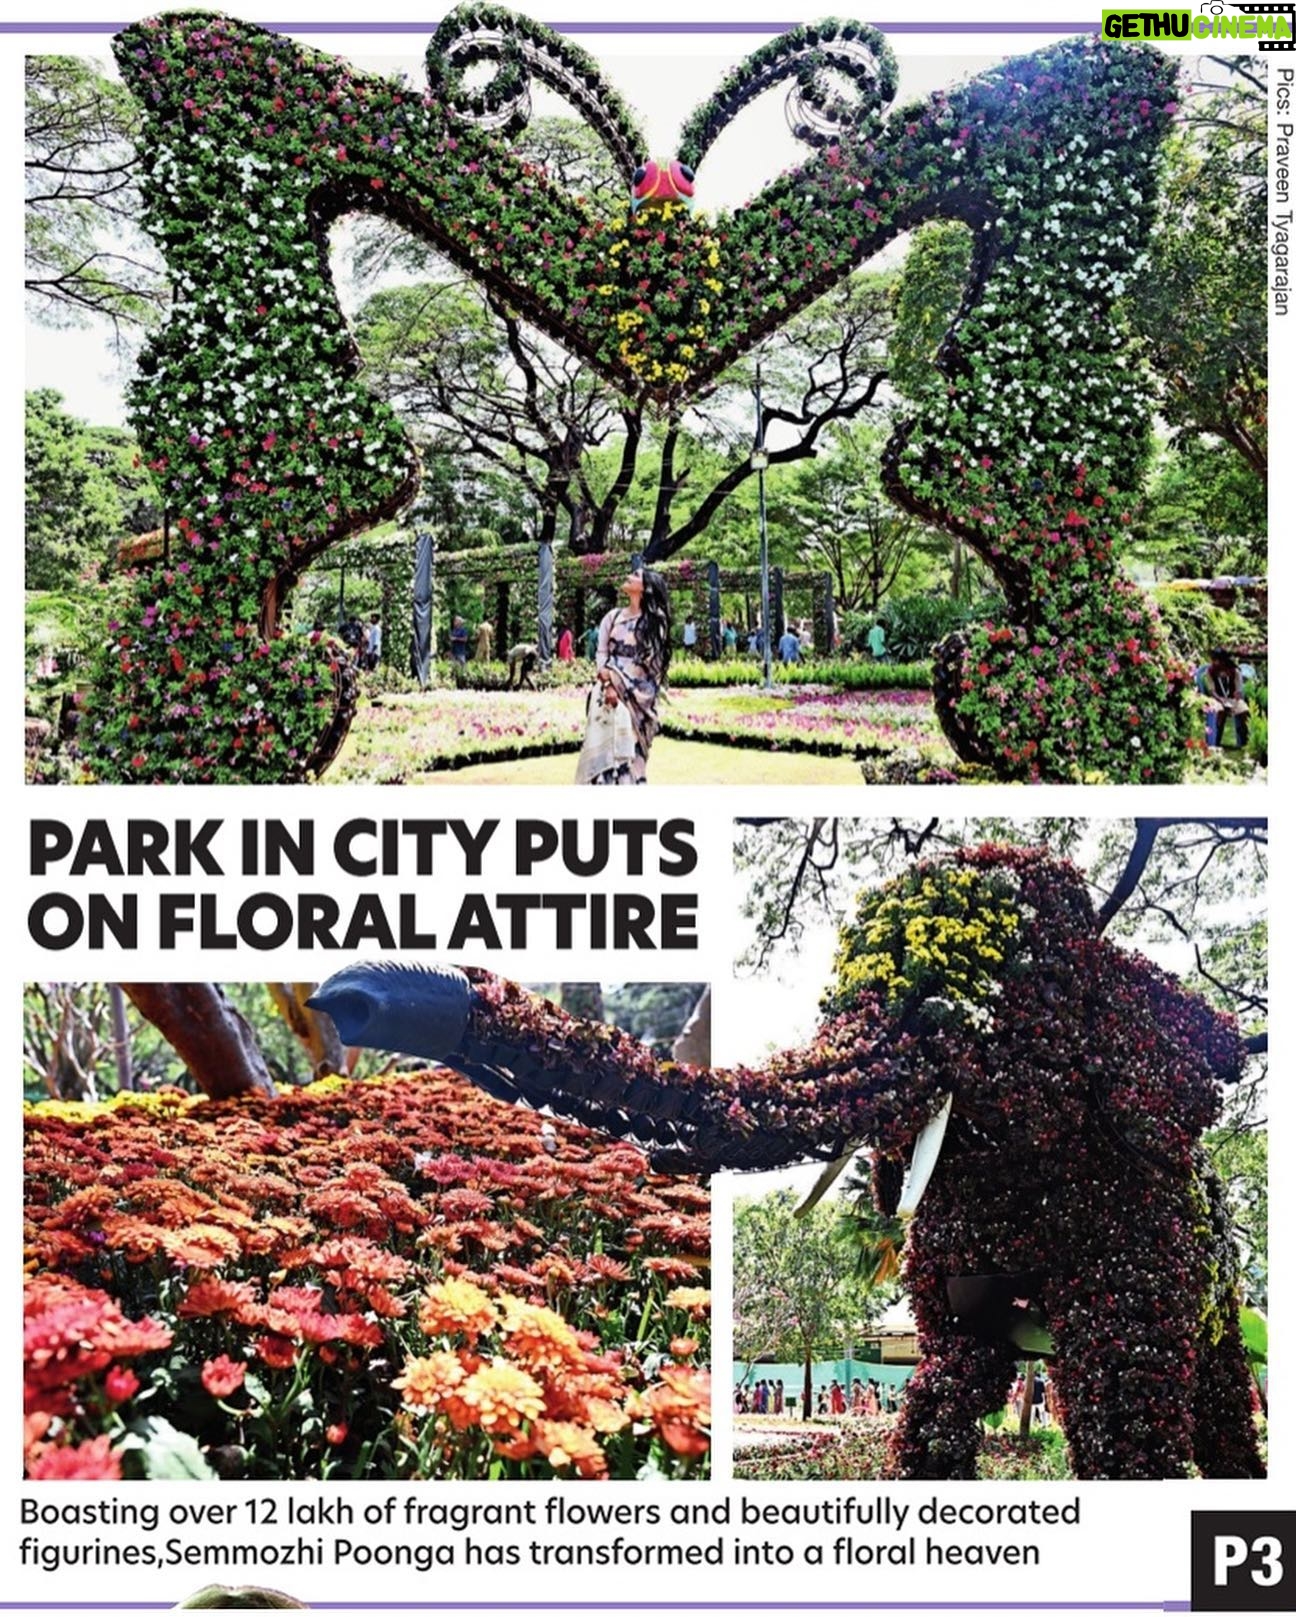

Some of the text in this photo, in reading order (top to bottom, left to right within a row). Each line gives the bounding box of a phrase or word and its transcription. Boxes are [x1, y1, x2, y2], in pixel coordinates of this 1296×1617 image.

[1271, 68, 1294, 316] Pics: Praveen Tyagarajan
[30, 818, 698, 877] PARK IN CITY PUTS
[28, 892, 698, 950] ON FLORAL ATTIRE
[21, 1497, 1080, 1531] Boasting over 12 lakh of fragrant flowers and beautifully decorated
[335, 1539, 454, 1571] Poonga
[465, 1537, 520, 1565] has
[529, 1537, 723, 1565] transformed
[734, 1537, 794, 1565] into
[804, 1545, 822, 1565] a
[833, 1537, 915, 1565] floral
[926, 1537, 1040, 1565] heaven
[1214, 1535, 1284, 1587] P3
